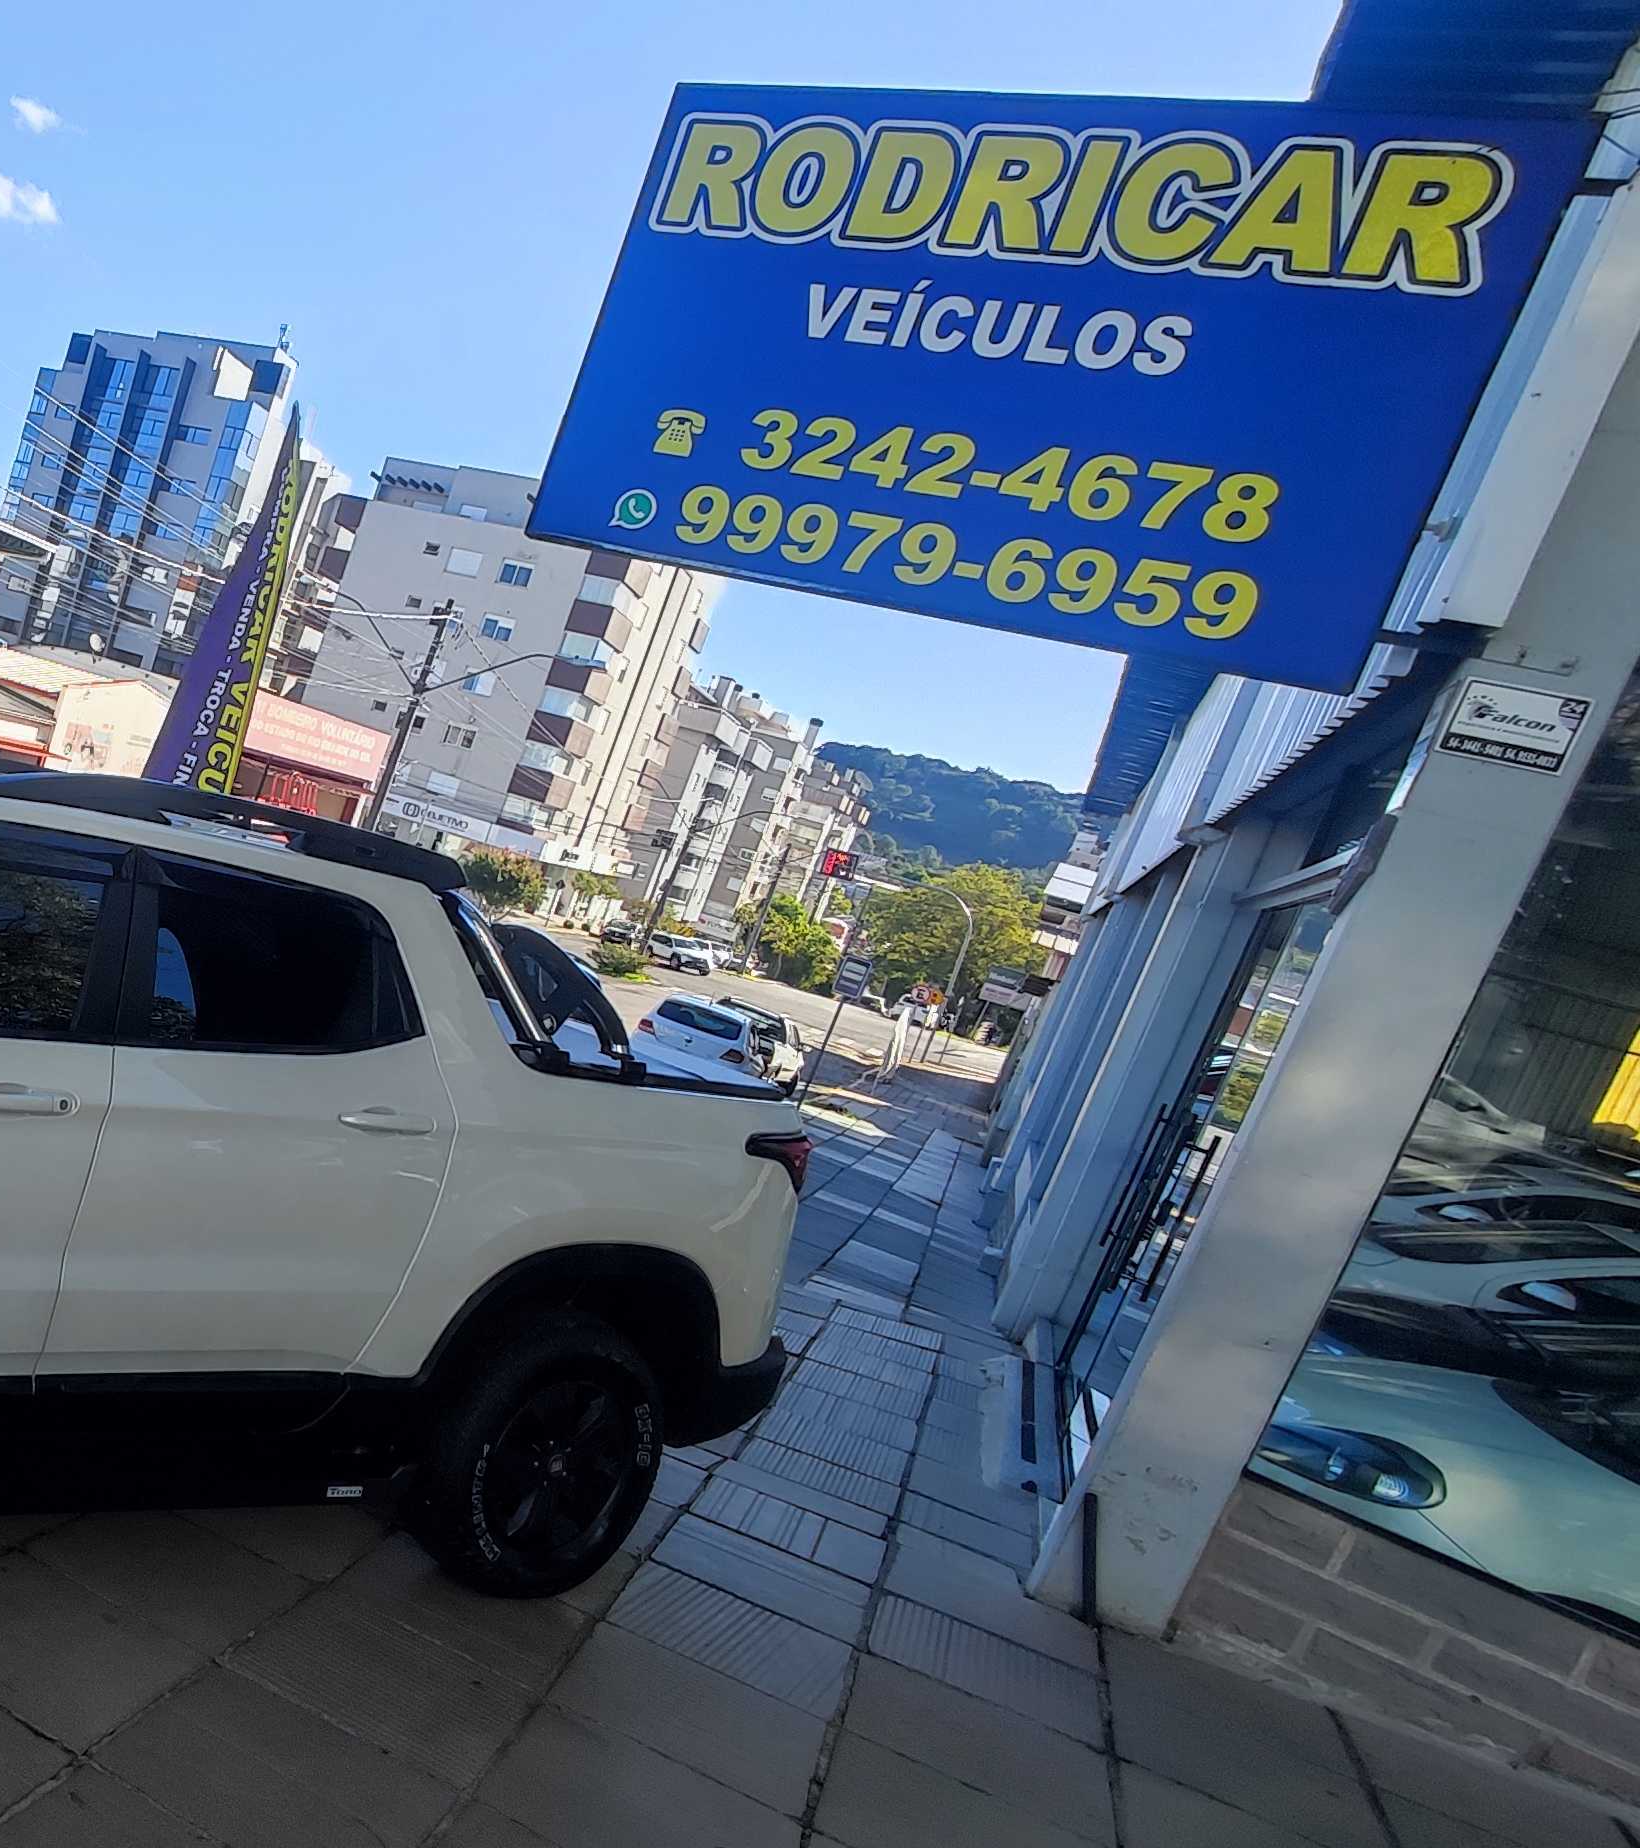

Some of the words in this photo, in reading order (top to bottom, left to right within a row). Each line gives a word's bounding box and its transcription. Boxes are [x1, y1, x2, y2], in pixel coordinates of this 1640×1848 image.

[652, 115, 1512, 295] RODRICAR
[806, 281, 1192, 376] VEÍCULOS
[740, 409, 1280, 543] 3242-4678
[674, 484, 1258, 641] 99979-6959
[228, 579, 260, 650] VENDA
[193, 668, 232, 737] TROCA
[1474, 704, 1557, 733] Falcon
